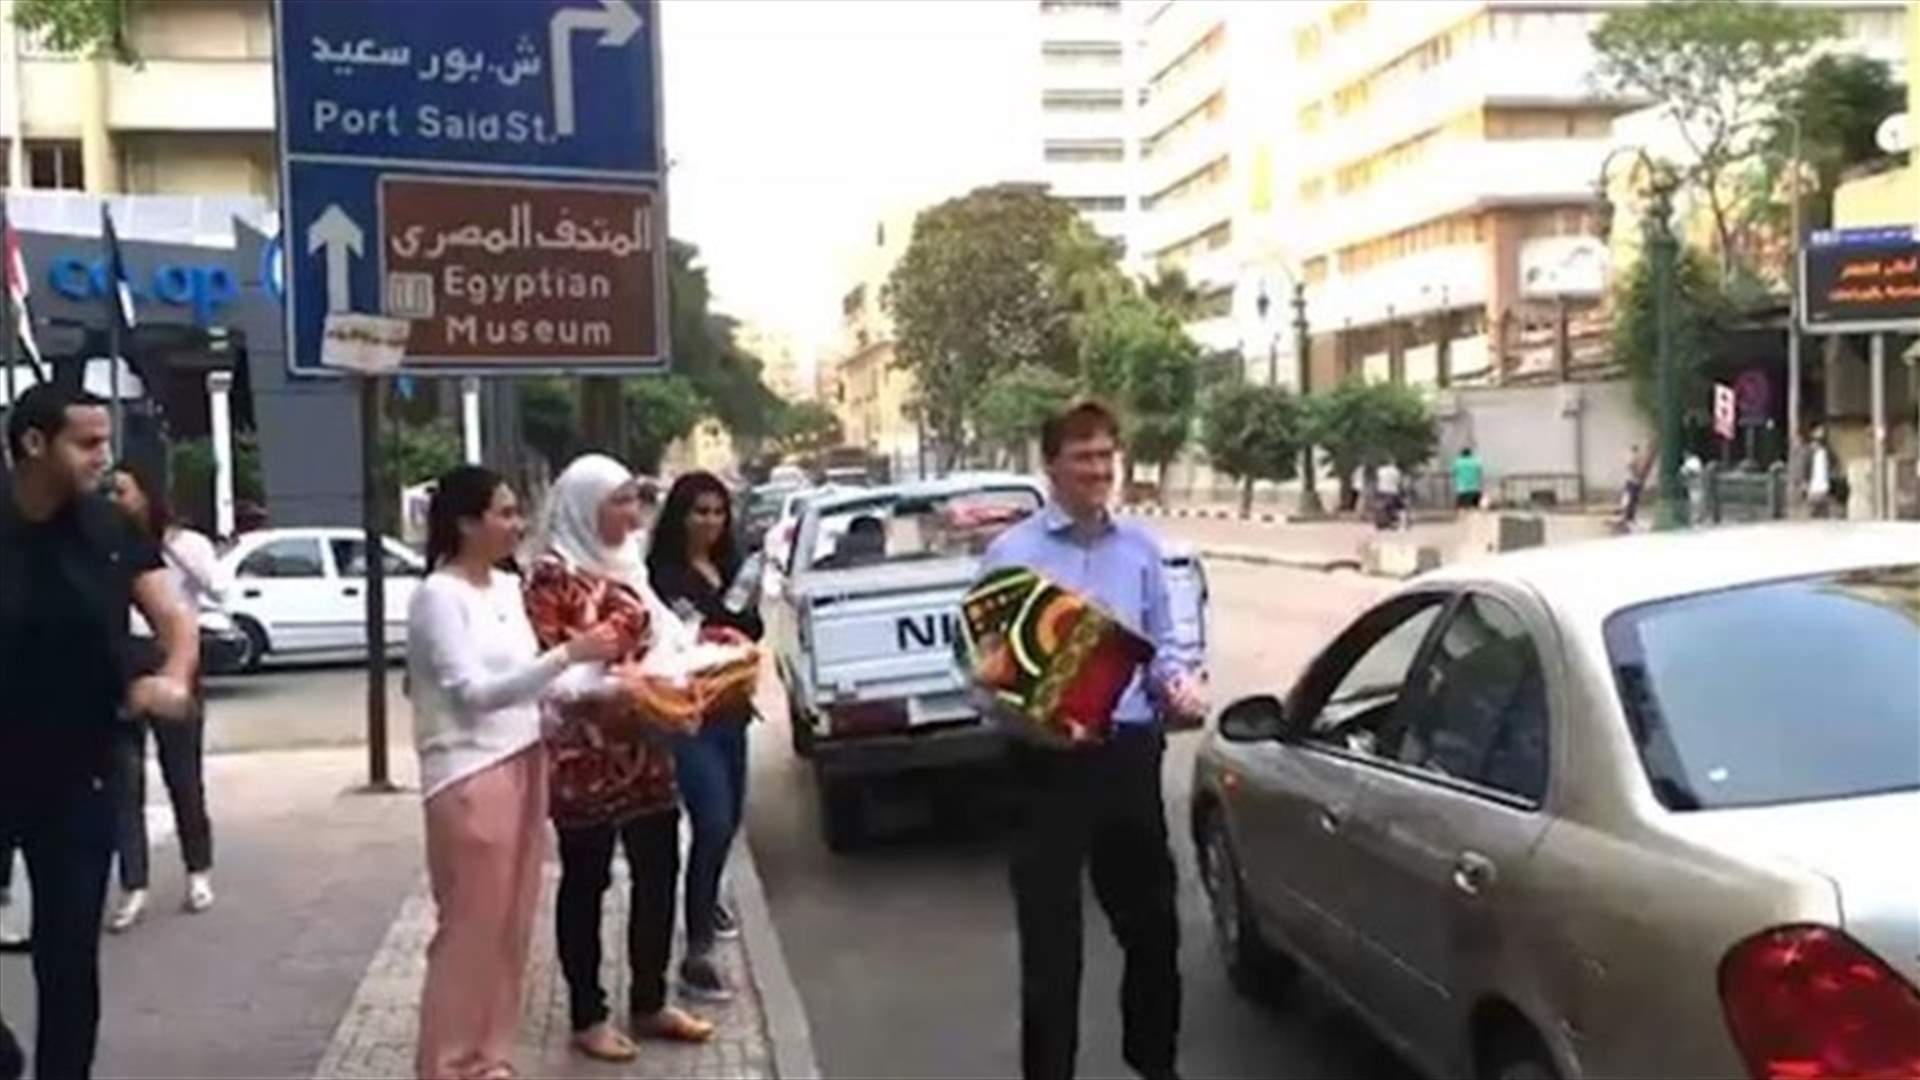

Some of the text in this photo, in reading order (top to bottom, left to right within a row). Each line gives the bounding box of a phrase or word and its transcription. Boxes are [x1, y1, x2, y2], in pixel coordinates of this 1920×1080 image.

[312, 36, 411, 77] سعيد
[314, 100, 558, 144] Port Said St.
[535, 205, 652, 258] المتحف
[444, 264, 612, 304] Egyptian
[446, 315, 612, 347] Museum
[897, 613, 960, 652] NI
